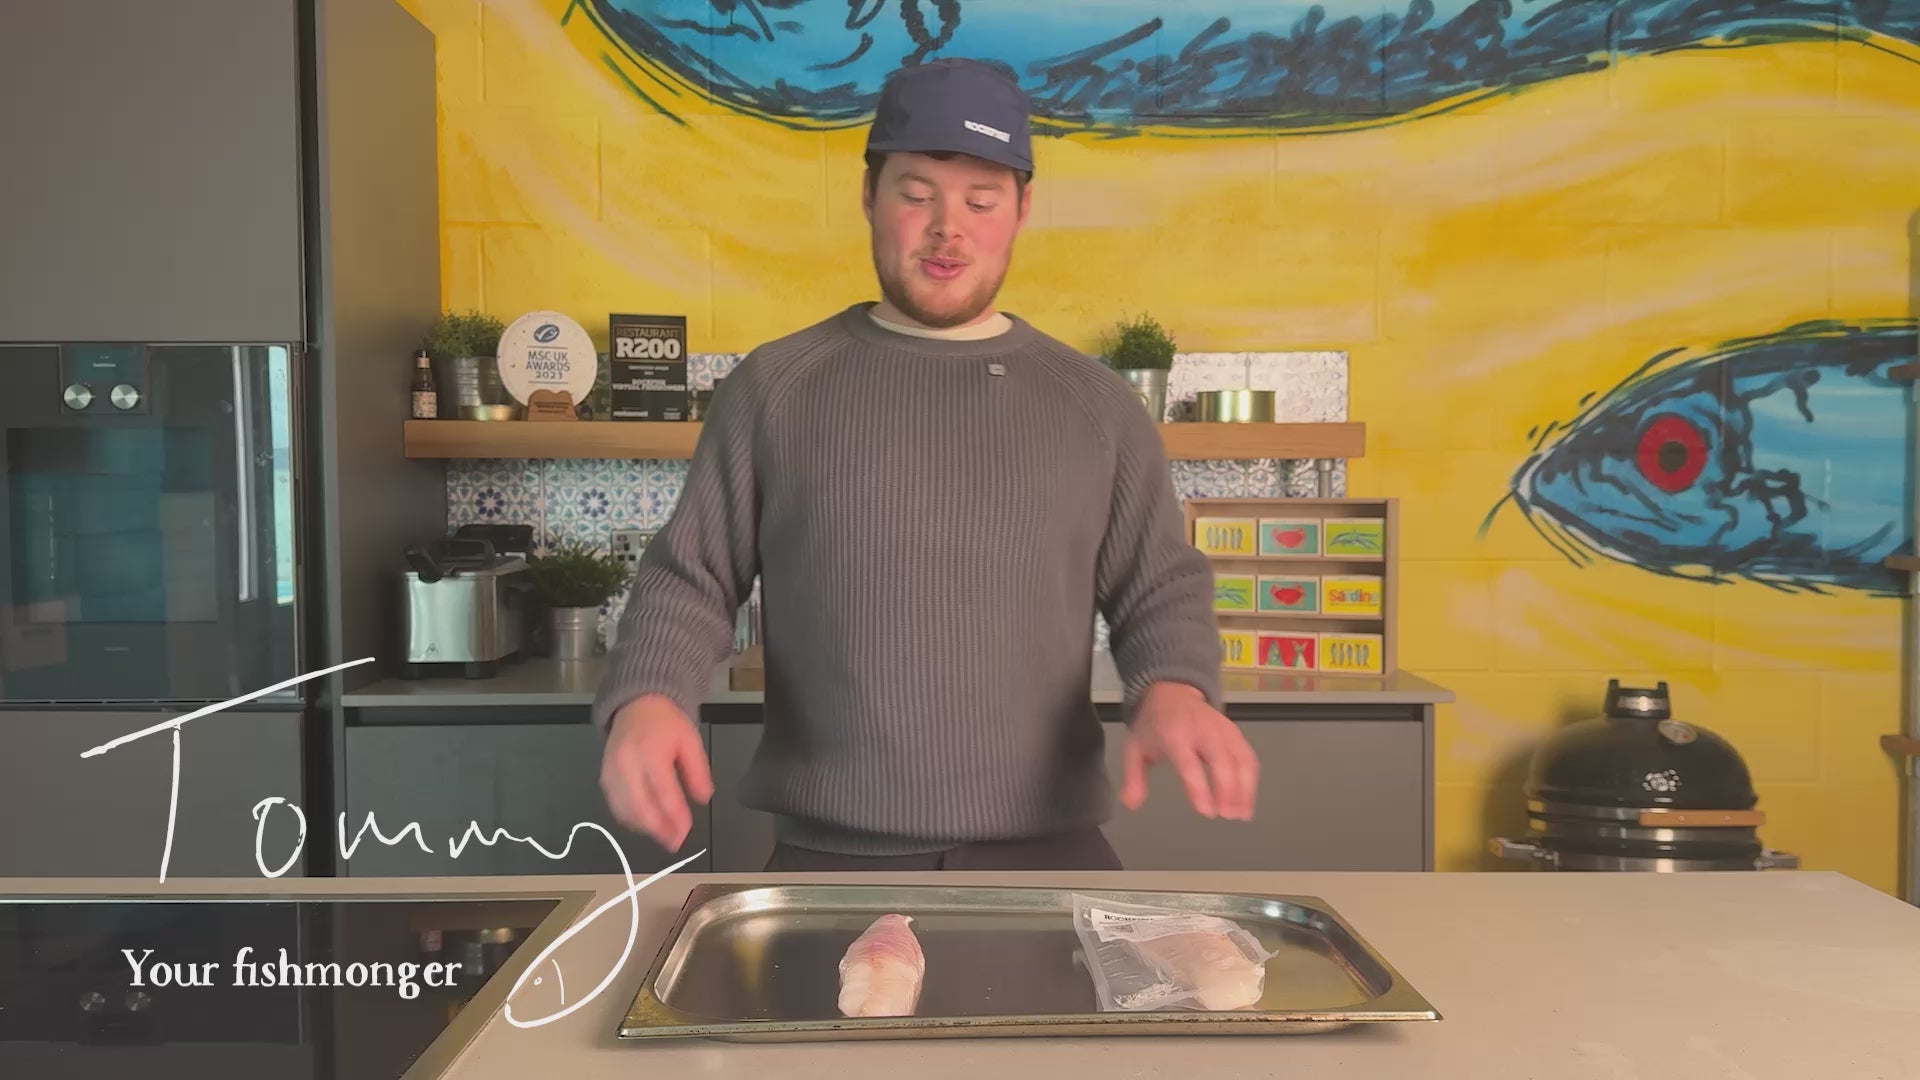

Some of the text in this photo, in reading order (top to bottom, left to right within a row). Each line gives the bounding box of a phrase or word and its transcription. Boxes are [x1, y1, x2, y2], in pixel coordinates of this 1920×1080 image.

[616, 328, 681, 338] RESTAURANT
[616, 337, 681, 360] R200
[528, 351, 569, 361] MSC UK
[526, 361, 570, 372] AWARDS
